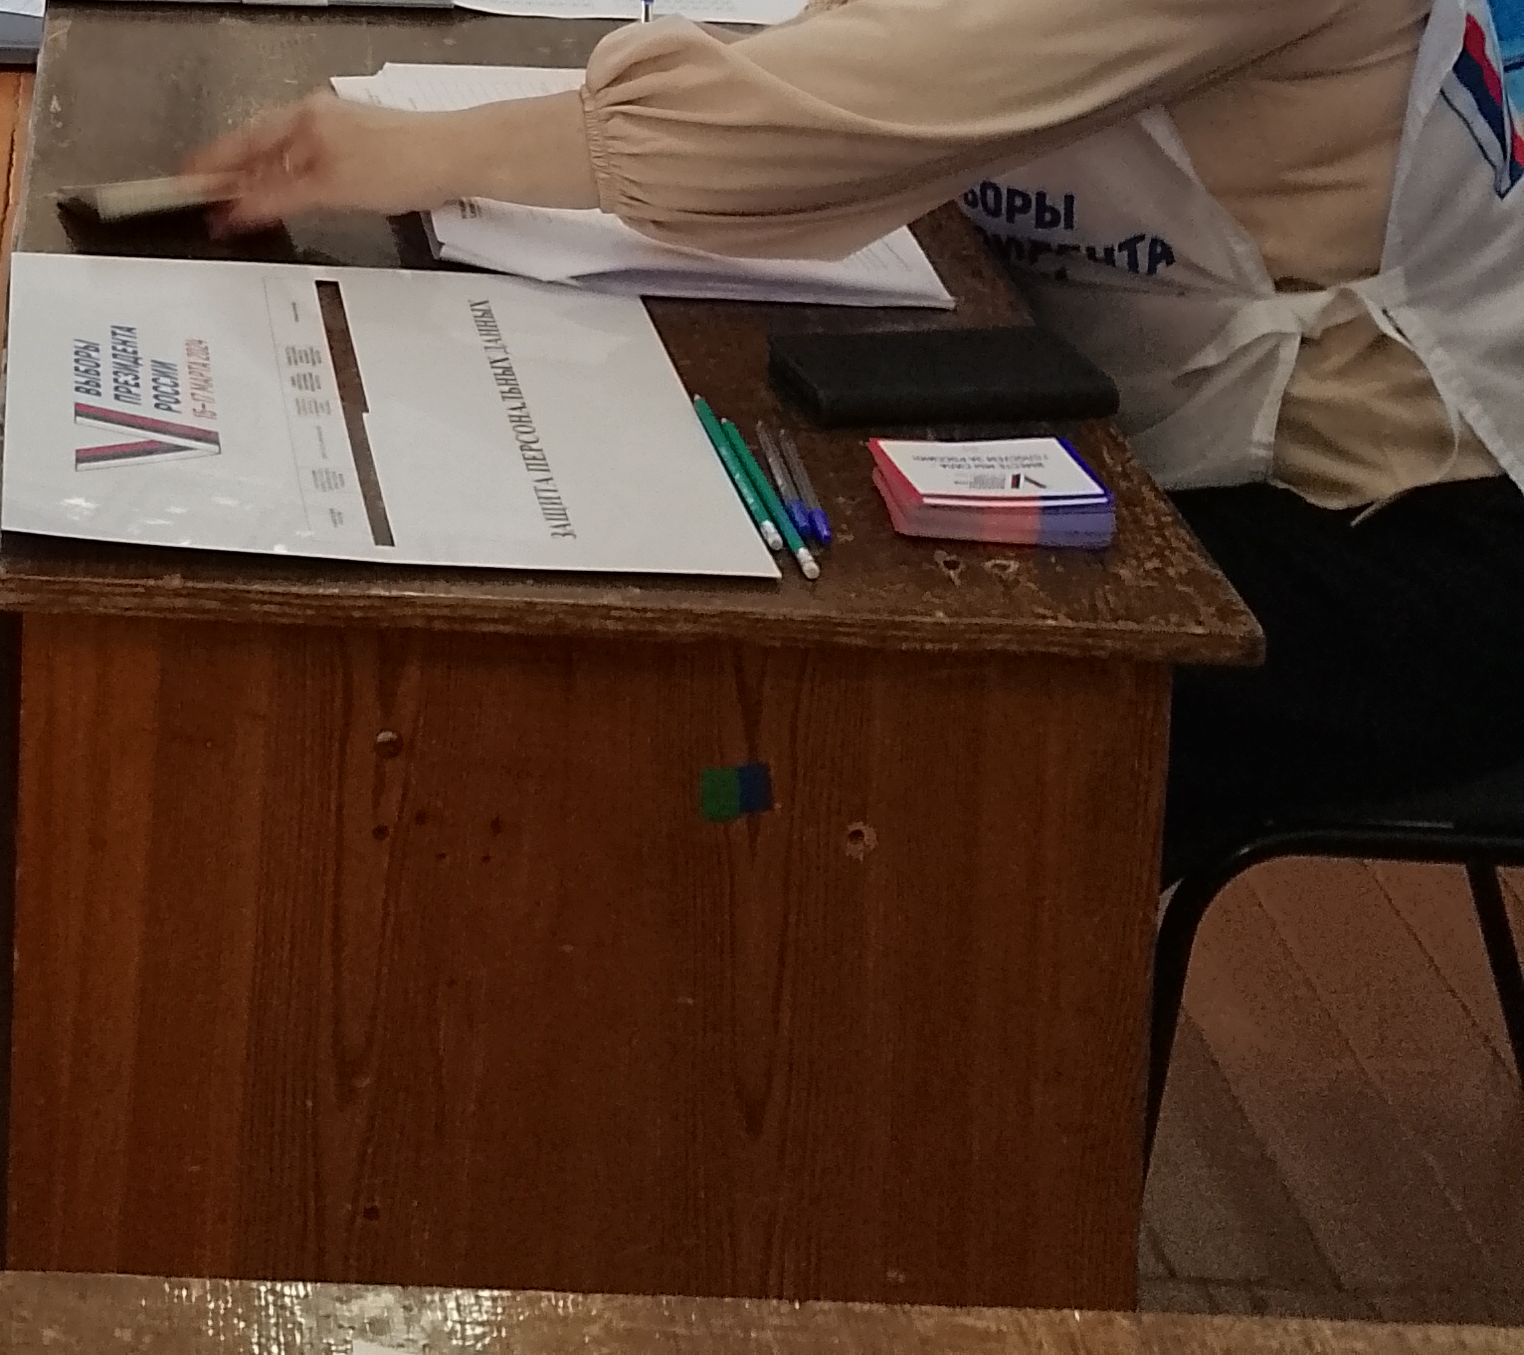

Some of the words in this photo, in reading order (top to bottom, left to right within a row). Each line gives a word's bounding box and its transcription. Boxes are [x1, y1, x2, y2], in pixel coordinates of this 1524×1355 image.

[184, 338, 209, 361] 2024
[468, 298, 509, 355] ДАННЫХ
[73, 338, 102, 398] ВЫБОРЫ
[110, 325, 143, 406] ПРЕЗИДЕНТА
[150, 360, 182, 414] РОССИИ
[187, 361, 213, 394] МАРТА
[487, 355, 551, 473] ПЕРСОНАЛЬНЫХ
[533, 476, 577, 540] ЗАЩИТА
